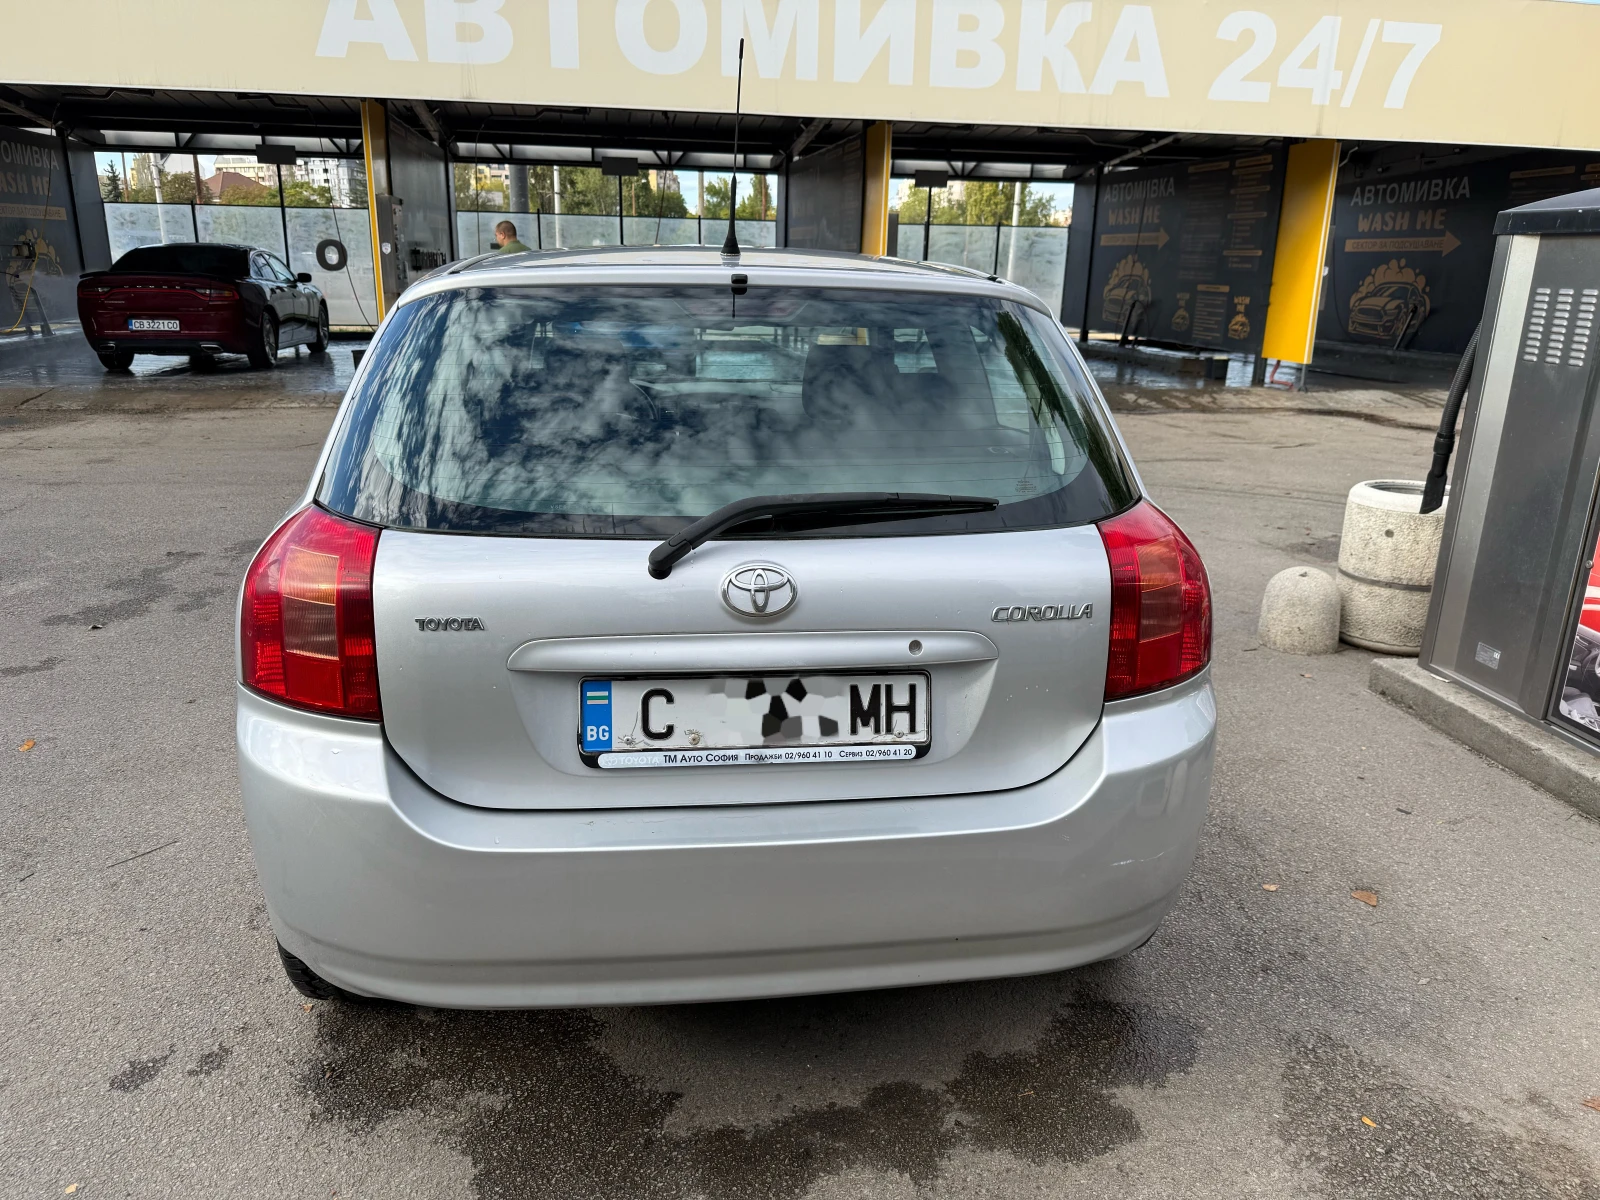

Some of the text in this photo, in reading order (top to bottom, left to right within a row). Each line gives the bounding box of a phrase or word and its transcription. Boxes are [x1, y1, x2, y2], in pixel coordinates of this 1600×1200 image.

[1207, 10, 1443, 110] 24/7
[1103, 177, 1175, 203] АВТОМИВКА
[1350, 176, 1471, 207] АВТОМИВКА
[1108, 207, 1139, 226] WASH
[1357, 209, 1447, 233] WASH ME
[1352, 241, 1377, 250] СЕКТОР
[133, 320, 178, 330] CB 3221 CO
[991, 602, 1094, 622] COROLLA
[415, 616, 485, 632] TOYOTA
[849, 683, 917, 735] MH
[586, 725, 610, 741] BG
[784, 752, 811, 761] 02/960
[812, 751, 822, 760] 41
[824, 751, 833, 759] 10
[865, 749, 891, 758] 02/960
[893, 749, 901, 757] 41
[903, 748, 913, 757] 20
